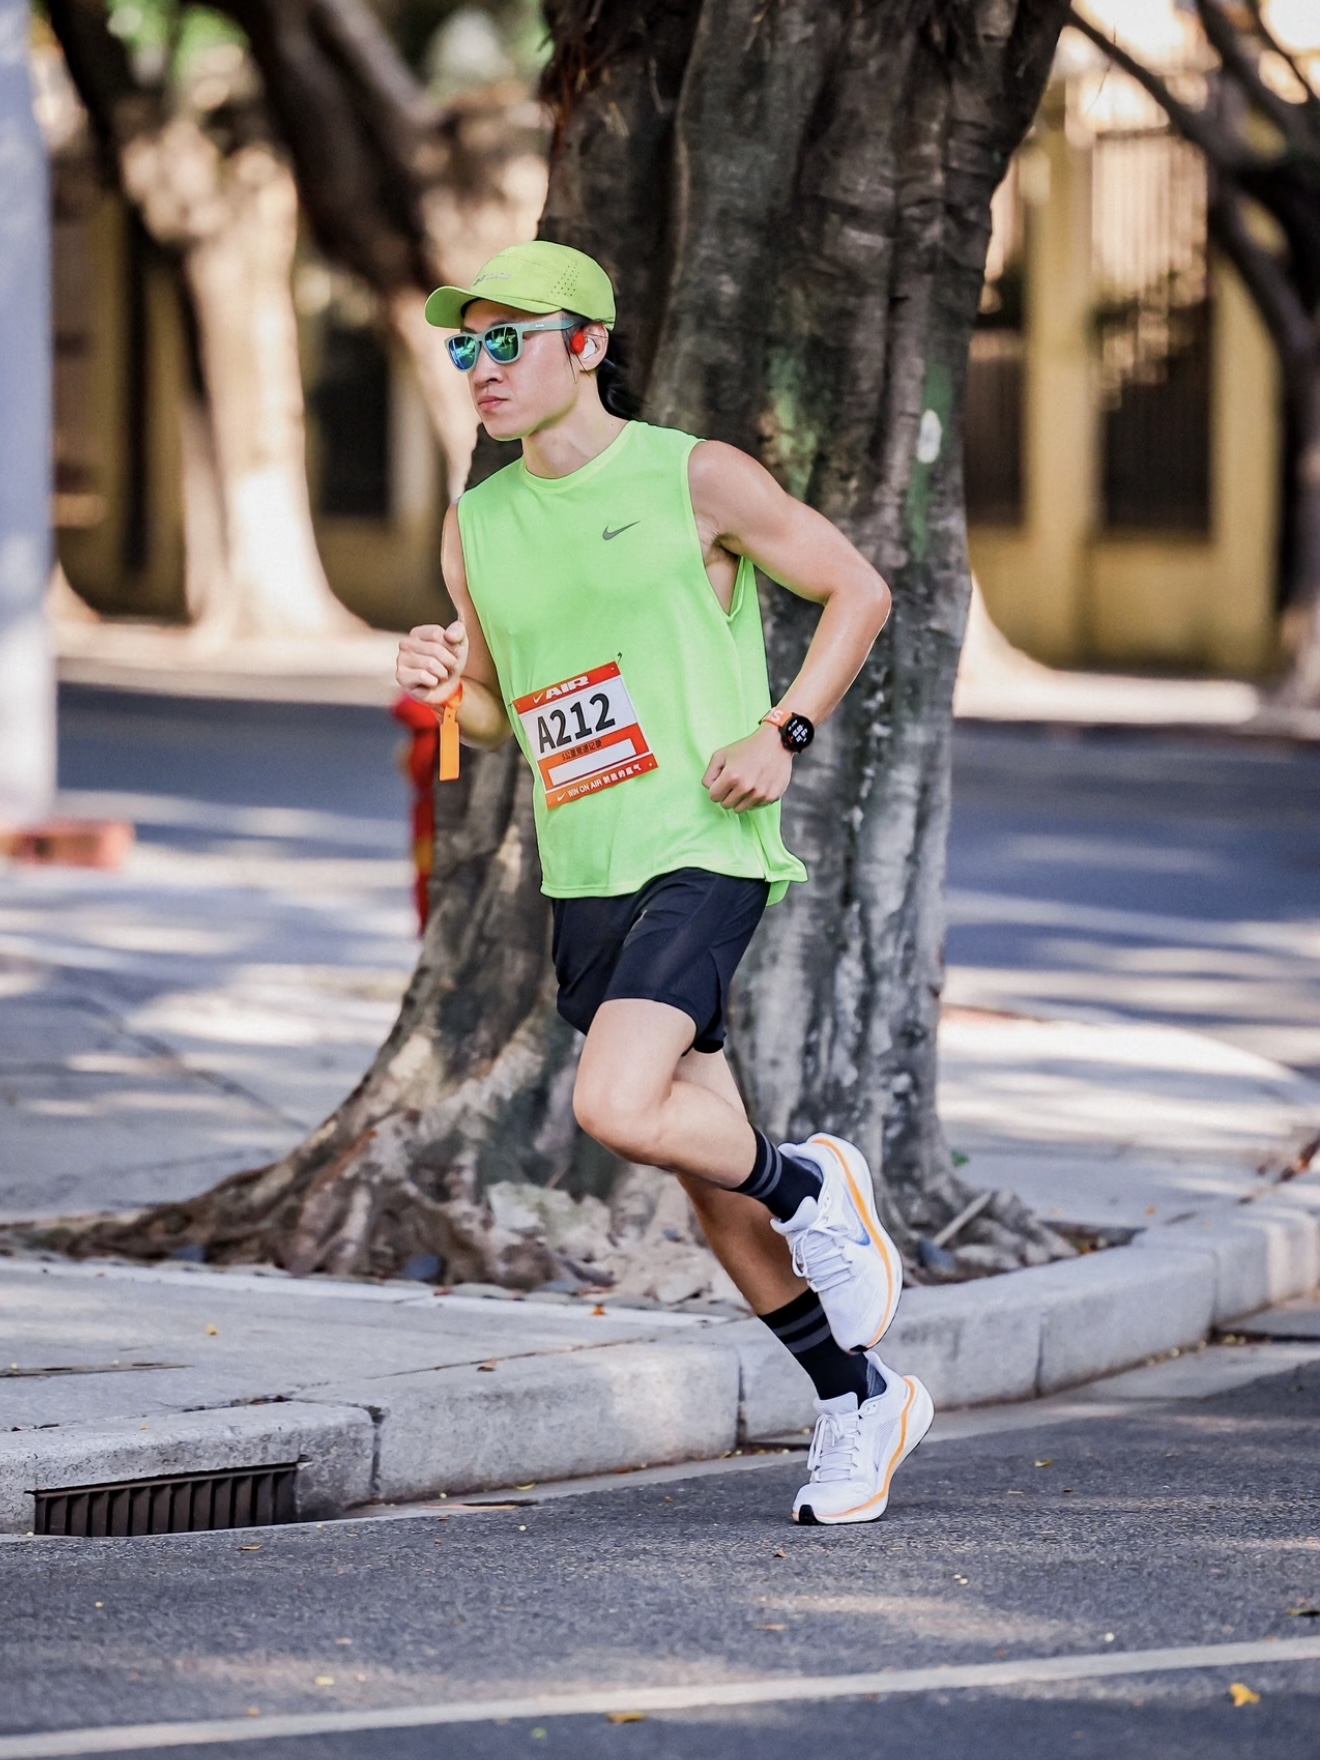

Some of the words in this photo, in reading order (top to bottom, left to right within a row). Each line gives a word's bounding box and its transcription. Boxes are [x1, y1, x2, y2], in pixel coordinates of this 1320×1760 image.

[546, 676, 589, 699] AIR
[538, 693, 615, 753] A212
[579, 784, 590, 793] ON
[590, 780, 602, 789] AIR
